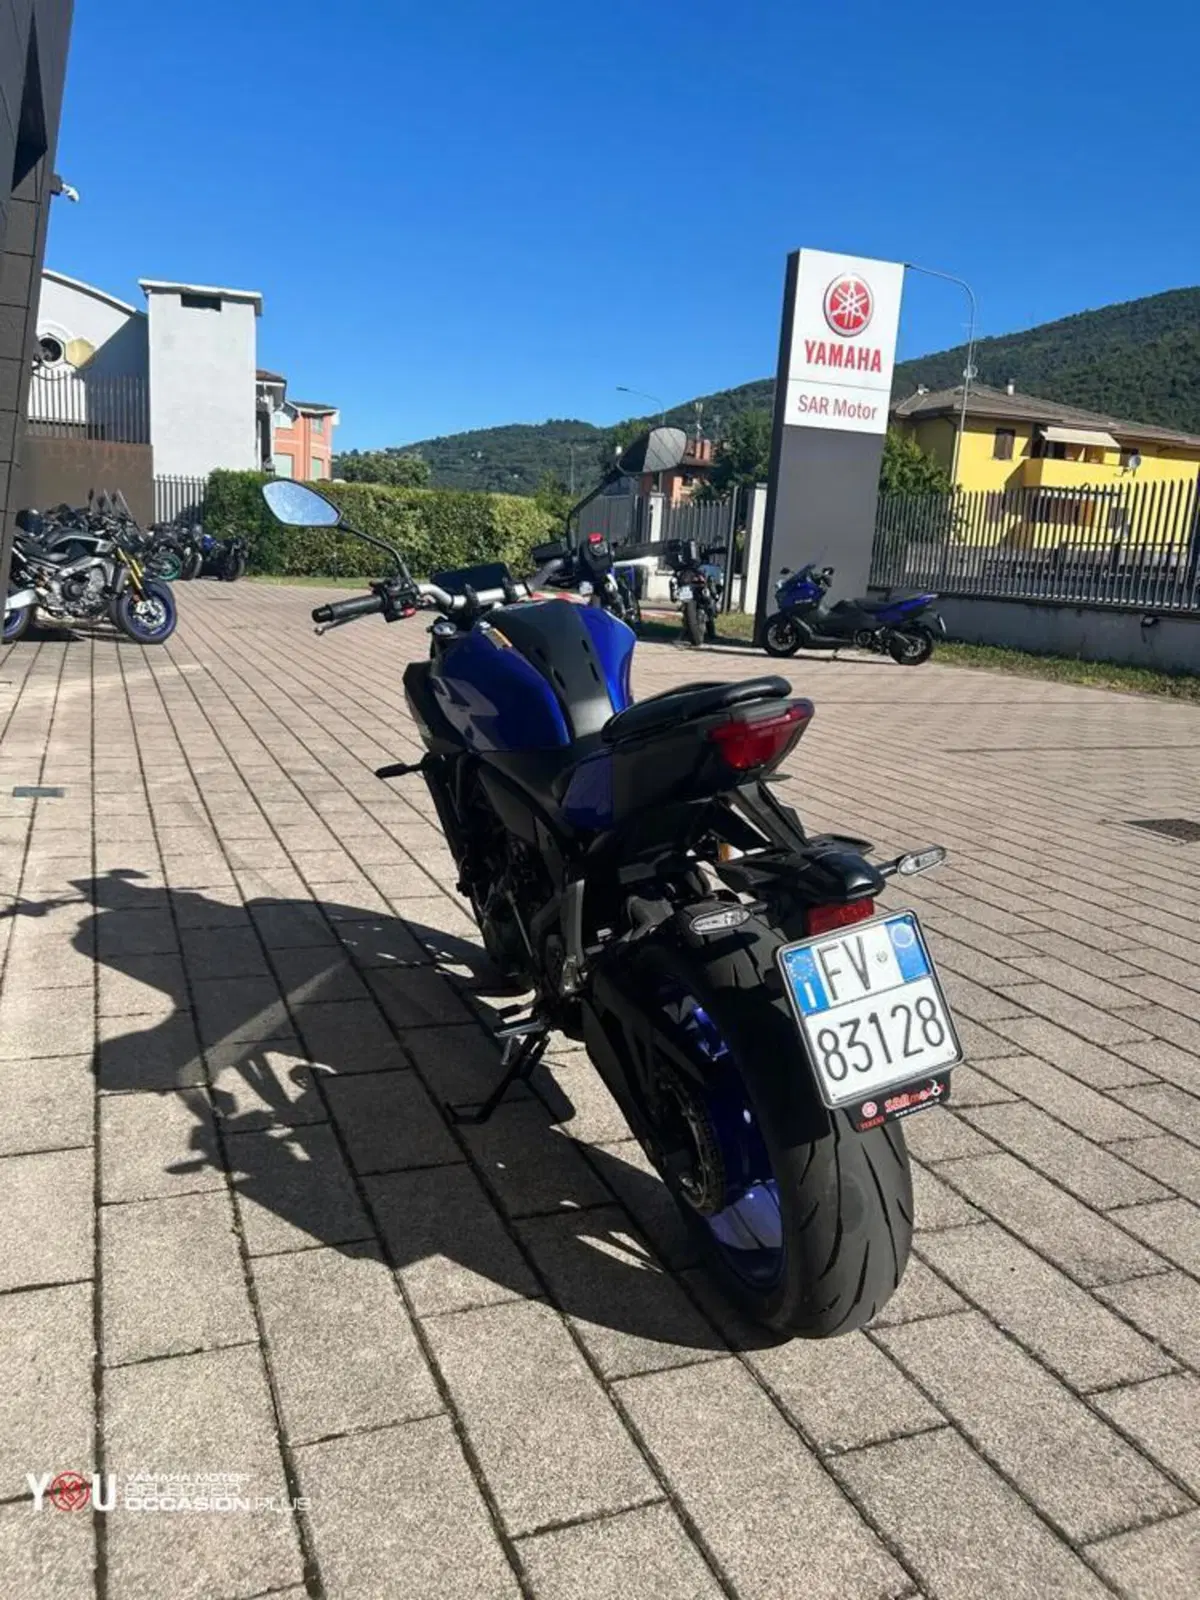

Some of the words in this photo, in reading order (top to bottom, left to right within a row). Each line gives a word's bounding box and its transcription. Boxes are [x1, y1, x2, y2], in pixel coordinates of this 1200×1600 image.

[804, 339, 882, 373] YAMAHA
[798, 394, 829, 416] SAR
[833, 398, 878, 420] Motor
[817, 935, 871, 1001] FV
[817, 996, 945, 1081] 83128
